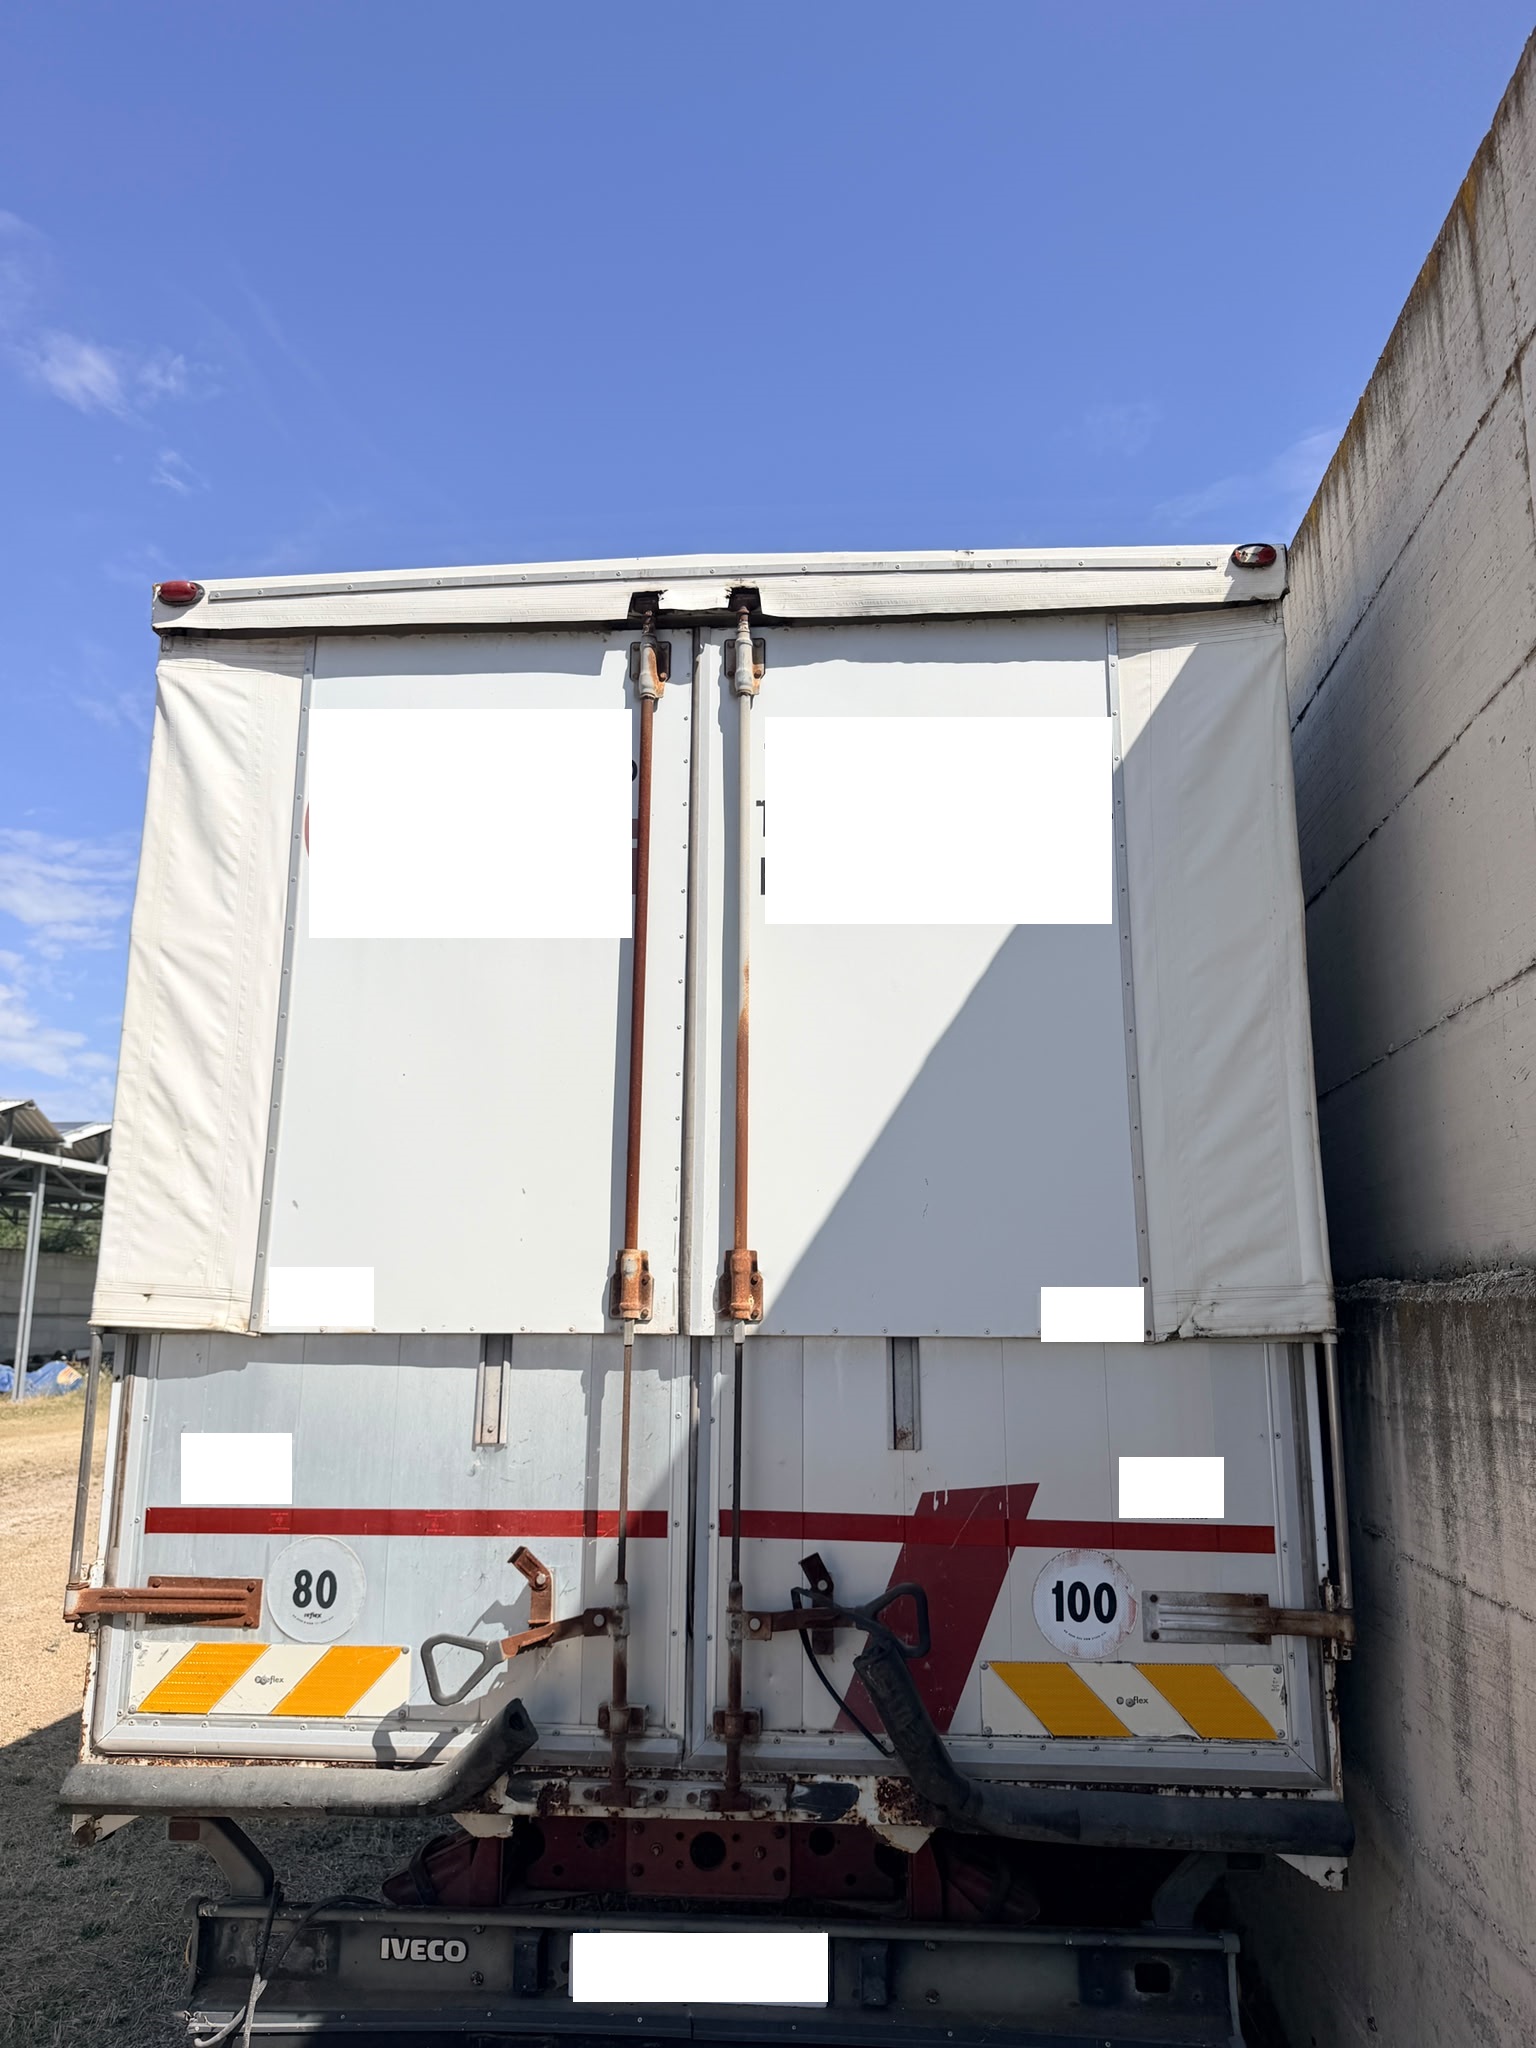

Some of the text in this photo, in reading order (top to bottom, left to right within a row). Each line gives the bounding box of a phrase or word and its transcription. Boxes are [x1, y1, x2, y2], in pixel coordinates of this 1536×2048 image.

[292, 1569, 337, 1609] 80
[1052, 1580, 1117, 1624] 100
[380, 1937, 467, 1963] IVECO
